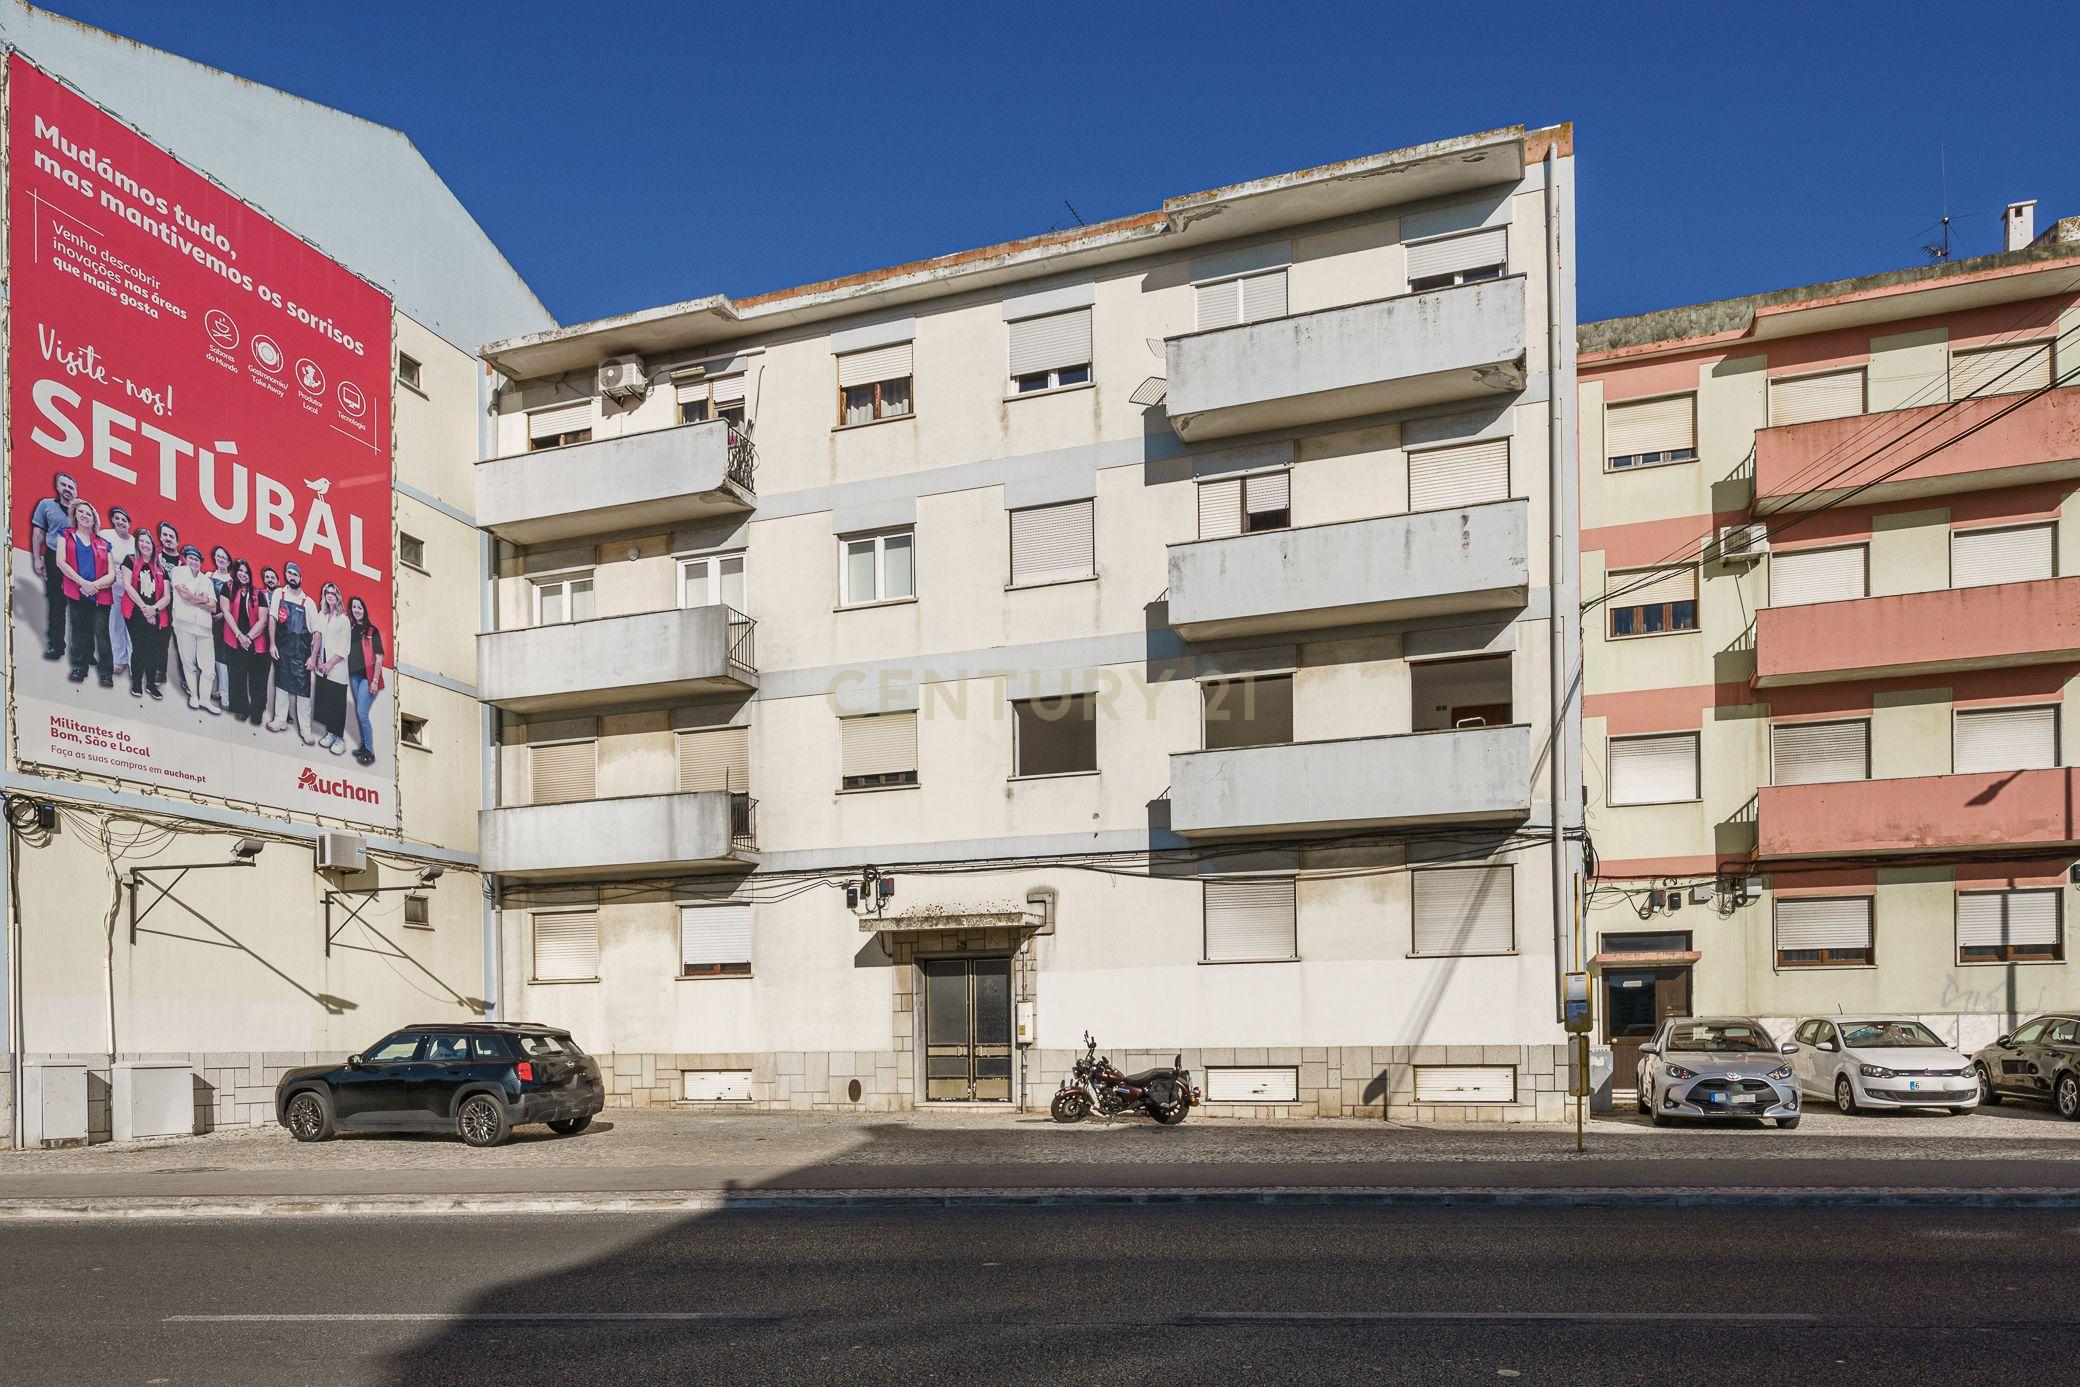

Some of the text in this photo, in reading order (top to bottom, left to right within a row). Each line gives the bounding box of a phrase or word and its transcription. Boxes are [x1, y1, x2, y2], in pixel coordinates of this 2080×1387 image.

[34, 114, 236, 261] Mudámos tudo,
[34, 149, 364, 356] mas mantivemos os sorrisos
[52, 220, 160, 290] Venha descobrir
[53, 236, 187, 319] inovações nas áreas
[53, 257, 159, 319] que mais gosta
[206, 352, 238, 374] do Mundo
[209, 344, 235, 362] Sabores
[248, 364, 289, 390] Gastronomia/
[251, 375, 285, 398] Take Away
[298, 390, 323, 408] Produtor
[302, 401, 319, 415] Local
[337, 410, 366, 431] Tecnologia
[30, 378, 382, 582] SETÚBAL
[50, 715, 131, 742] Militantes do
[50, 727, 151, 757] Bom, São e Local
[51, 744, 207, 784] Faça as suas compras em auchan.pt
[298, 766, 379, 805] Auchan
